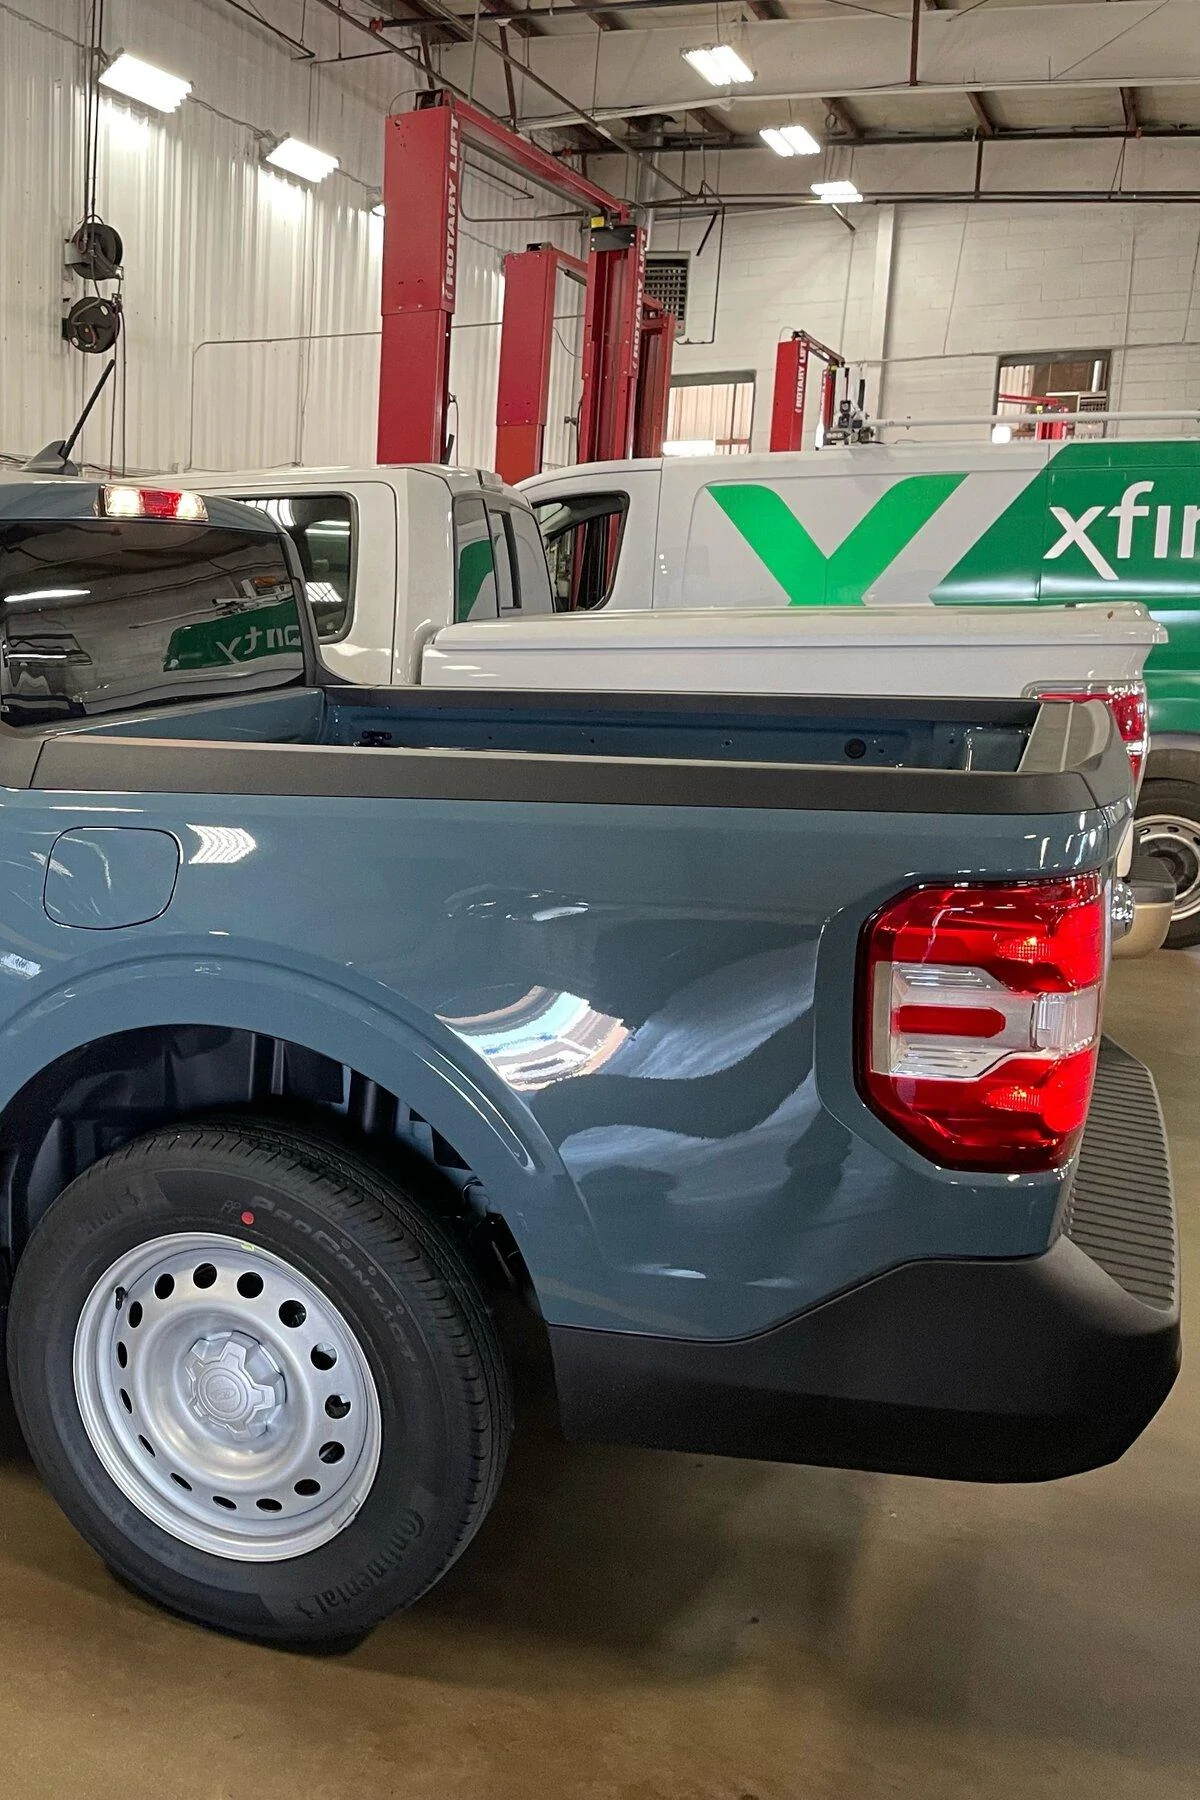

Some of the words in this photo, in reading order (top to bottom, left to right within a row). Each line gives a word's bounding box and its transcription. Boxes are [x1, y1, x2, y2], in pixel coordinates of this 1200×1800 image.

[450, 113, 458, 172] LIFT
[446, 178, 456, 286] ROTARY
[796, 366, 805, 408] ROTARY
